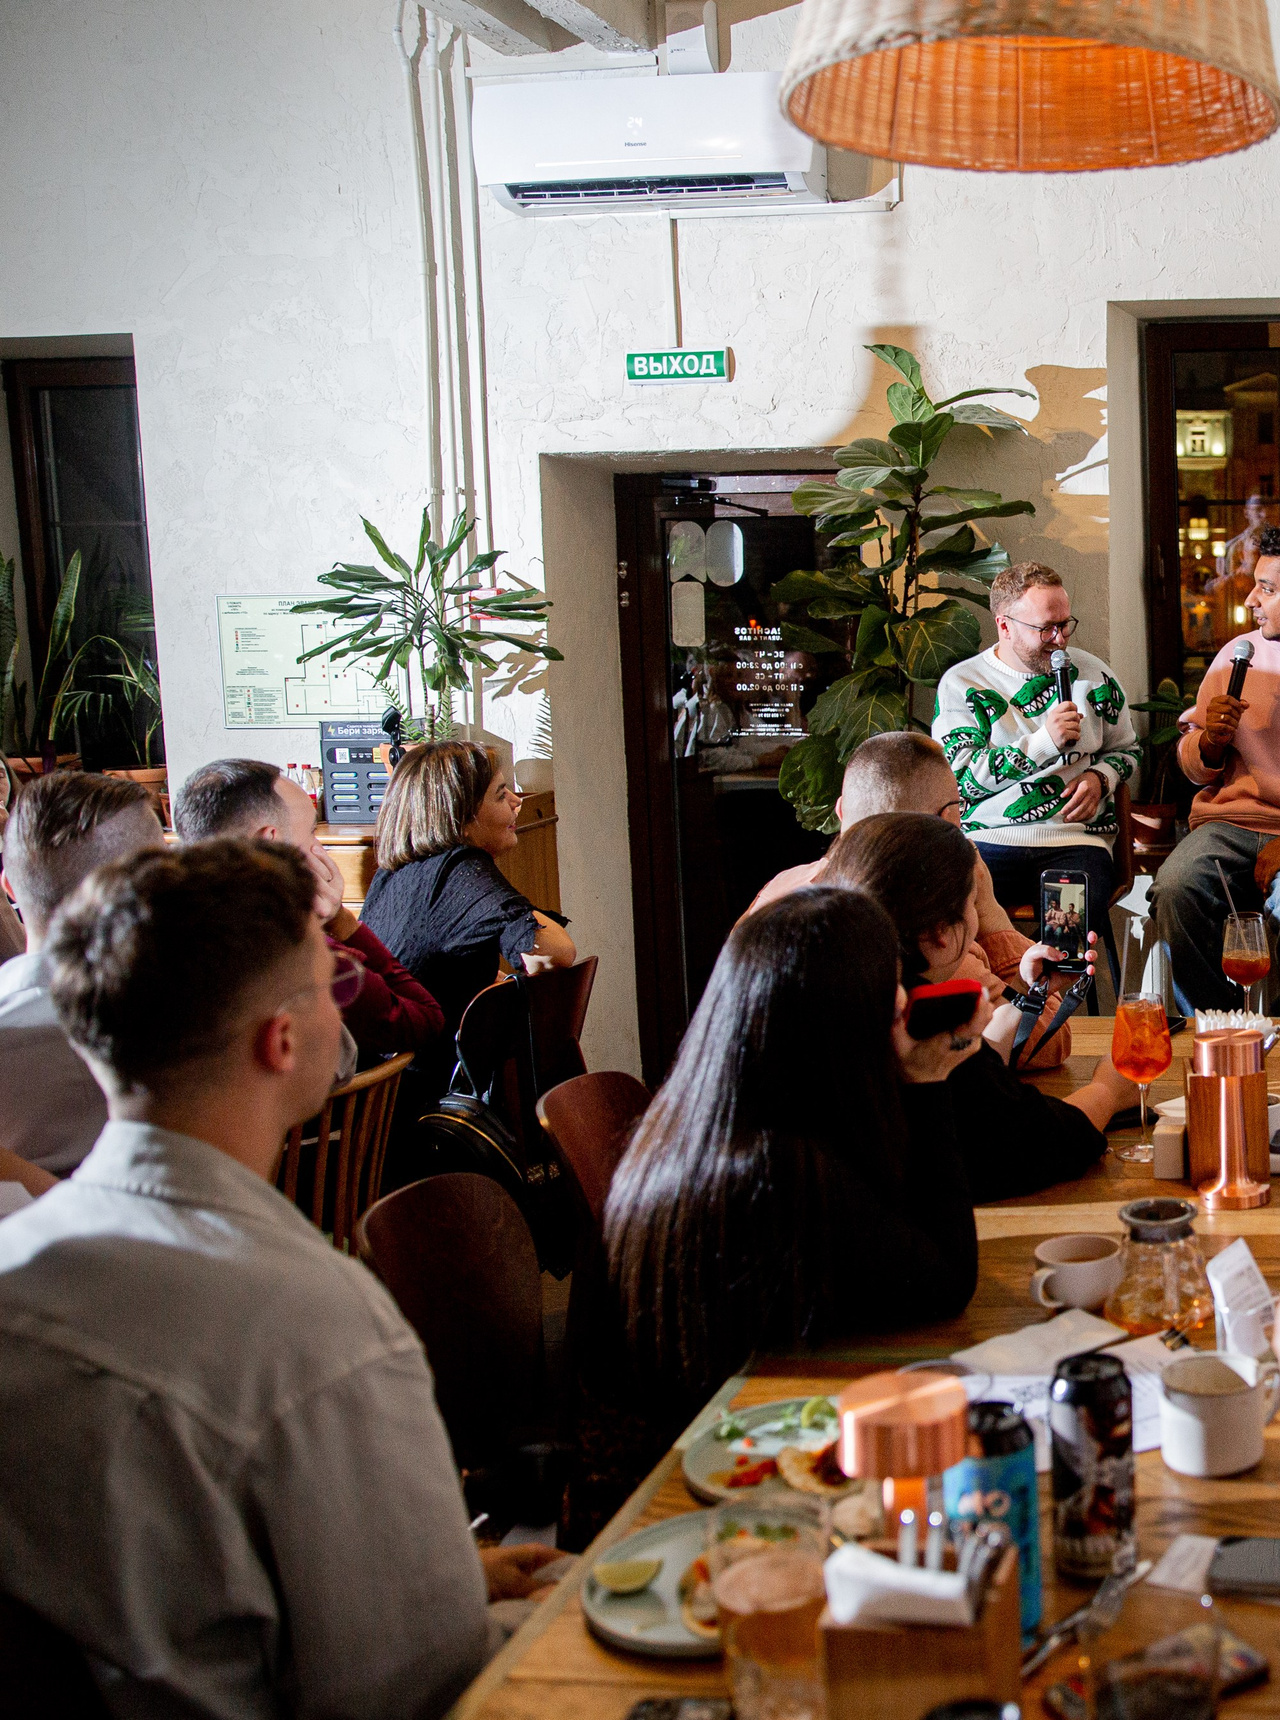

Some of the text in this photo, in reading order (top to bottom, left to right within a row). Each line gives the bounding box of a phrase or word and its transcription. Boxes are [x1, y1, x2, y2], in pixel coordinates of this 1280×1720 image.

[626, 116, 643, 128] 24
[633, 354, 718, 376] ВЫХОД
[337, 727, 360, 735] Бери
